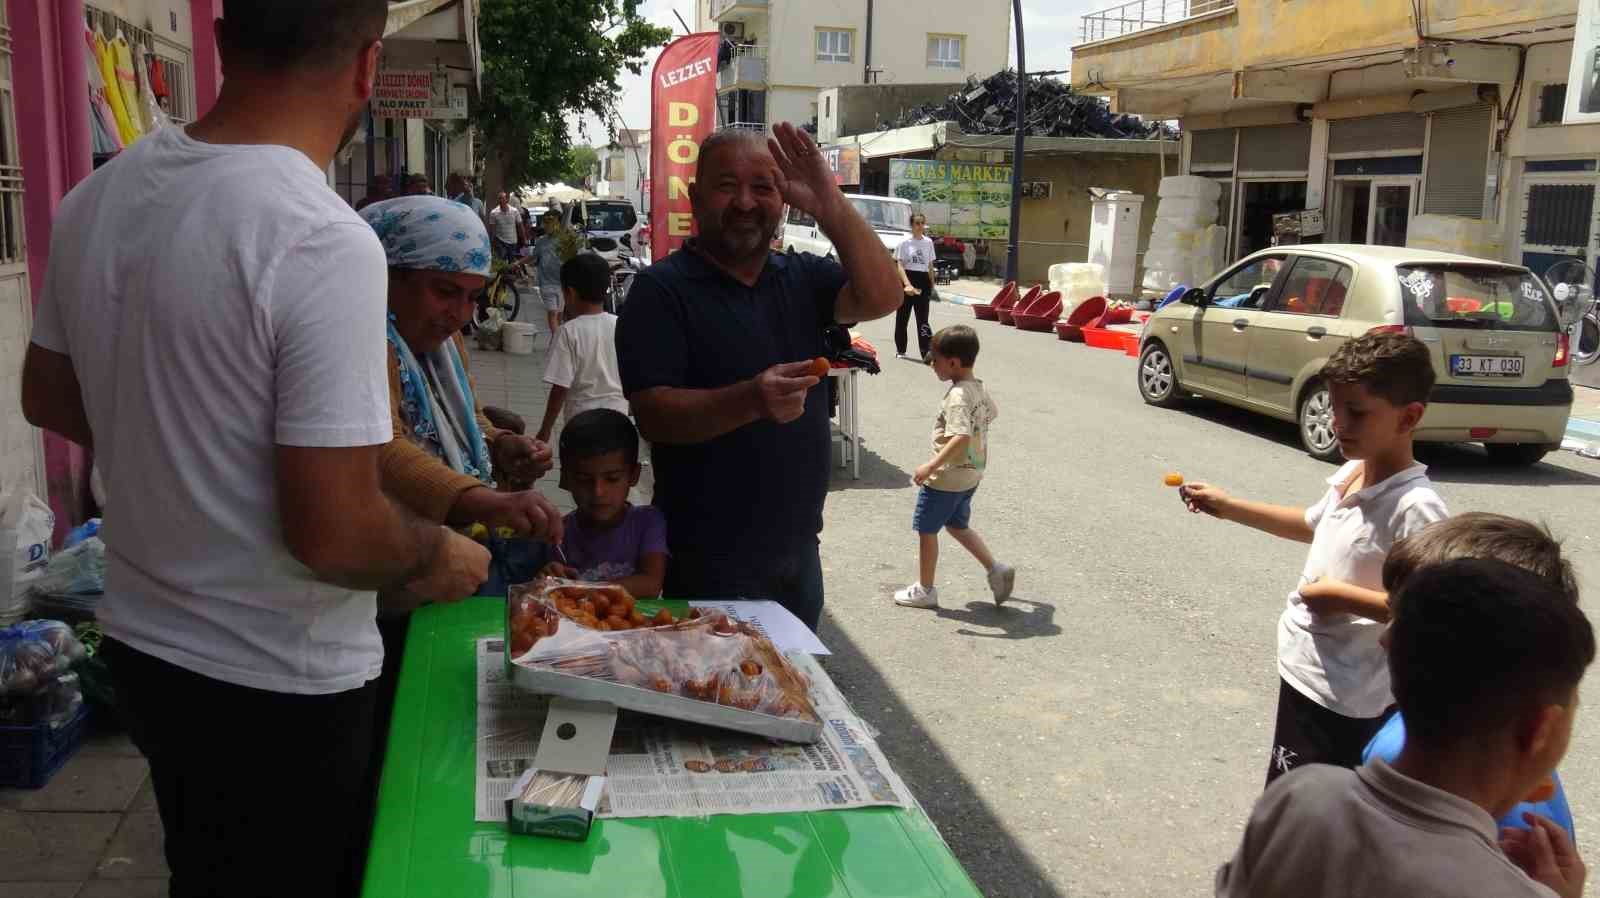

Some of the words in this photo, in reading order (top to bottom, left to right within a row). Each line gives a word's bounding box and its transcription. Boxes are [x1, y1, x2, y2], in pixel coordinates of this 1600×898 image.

[659, 57, 712, 88] LEZZET
[667, 101, 700, 250] DÖNE
[906, 163, 946, 179] ARAS
[951, 165, 1011, 181] MARKET
[1458, 358, 1472, 370] 33
[1480, 358, 1493, 371] KT
[1501, 359, 1520, 371] 030
